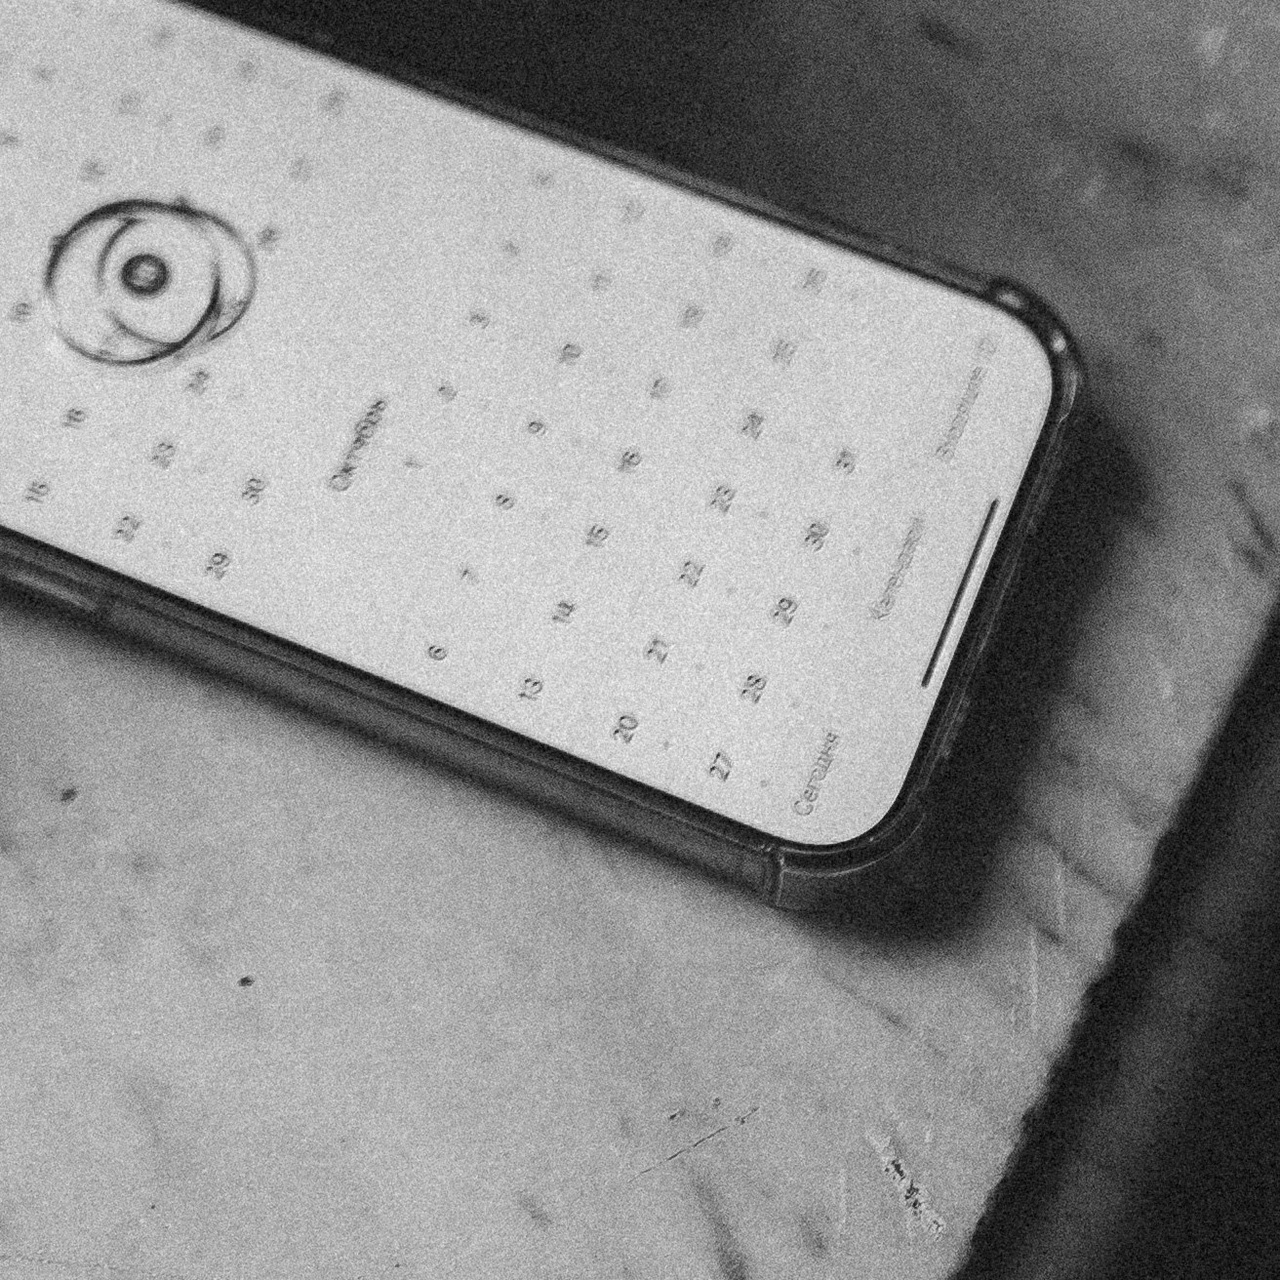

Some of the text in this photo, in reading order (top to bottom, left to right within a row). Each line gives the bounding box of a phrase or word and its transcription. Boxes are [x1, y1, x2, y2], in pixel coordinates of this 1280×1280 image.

[325, 395, 390, 494] Октябрь
[112, 512, 144, 544] 22
[203, 473, 268, 581] 29 30
[424, 642, 449, 663] 6
[492, 490, 517, 511] 8
[516, 447, 644, 702] 13 14 15 16
[610, 711, 641, 746] 20
[642, 634, 669, 666] 21
[676, 557, 706, 590] 22
[706, 482, 737, 516] 23
[705, 748, 733, 784] 27
[737, 671, 769, 706] 28
[768, 594, 800, 628] 29
[801, 518, 831, 552] 30
[790, 729, 842, 819] Сегодня
